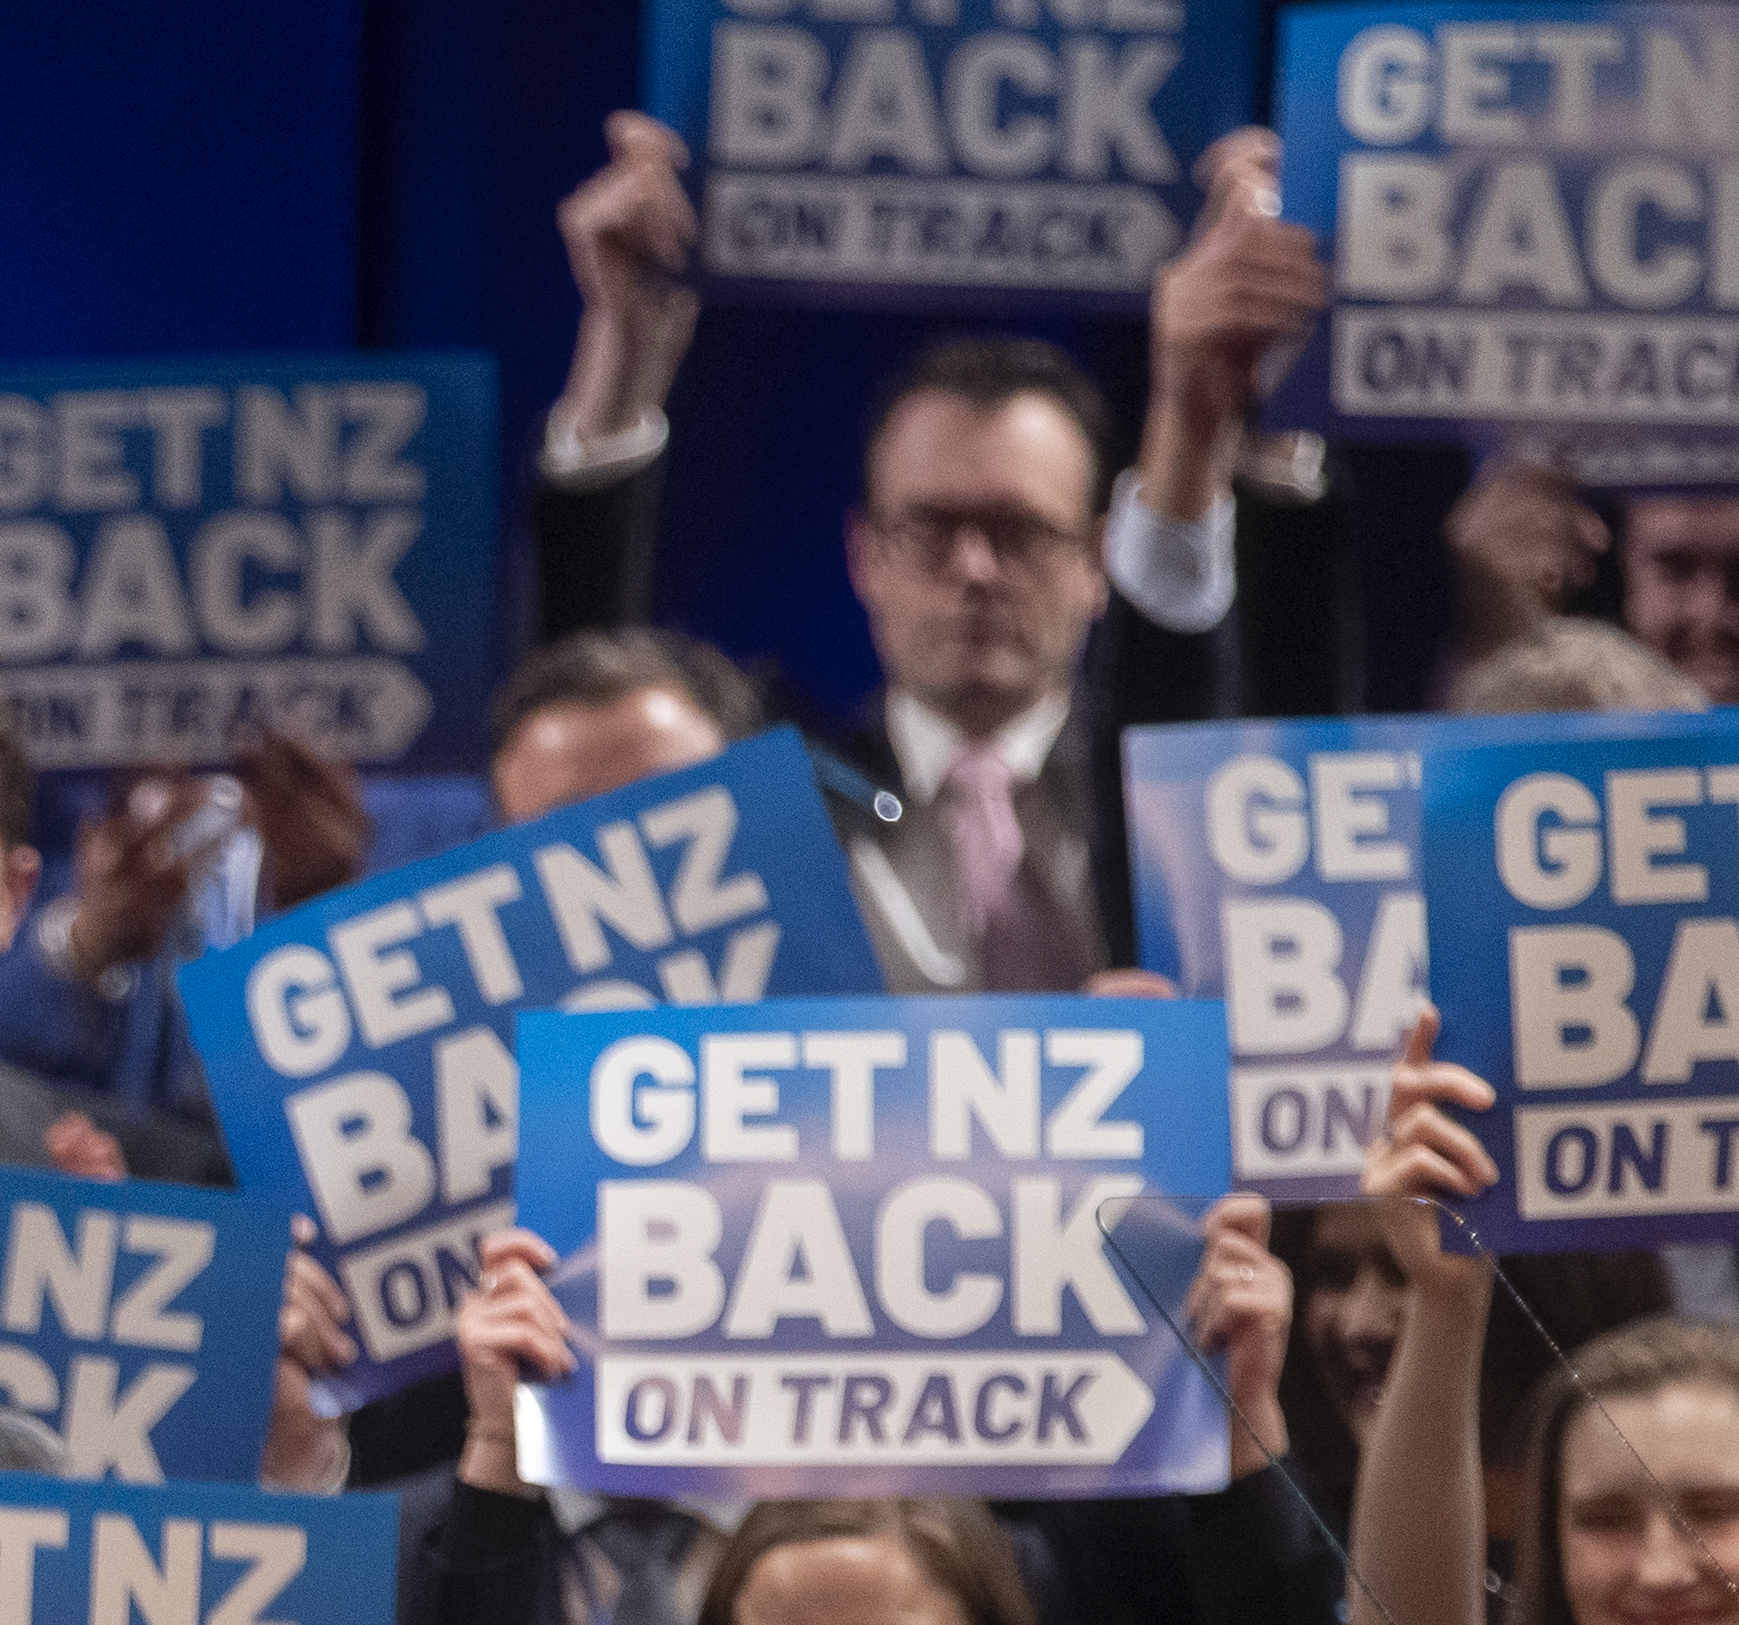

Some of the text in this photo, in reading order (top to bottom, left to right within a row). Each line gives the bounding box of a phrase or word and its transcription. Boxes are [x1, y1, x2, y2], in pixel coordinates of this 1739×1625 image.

[711, 21, 1186, 184] BACK
[1336, 19, 1621, 148] GET
[1335, 152, 1739, 310] BAC
[1359, 331, 1475, 394] ON
[231, 380, 426, 502] NZ
[1206, 752, 1420, 888] GE
[246, 786, 770, 1080] GET NZ
[590, 1028, 1145, 1167] GET NZ
[1261, 1086, 1376, 1157] ON
[1543, 1122, 1669, 1199] ON
[0, 1203, 216, 1353] NZ
[597, 1175, 1147, 1342] BACK
[623, 1374, 1101, 1446] ON TRACK
